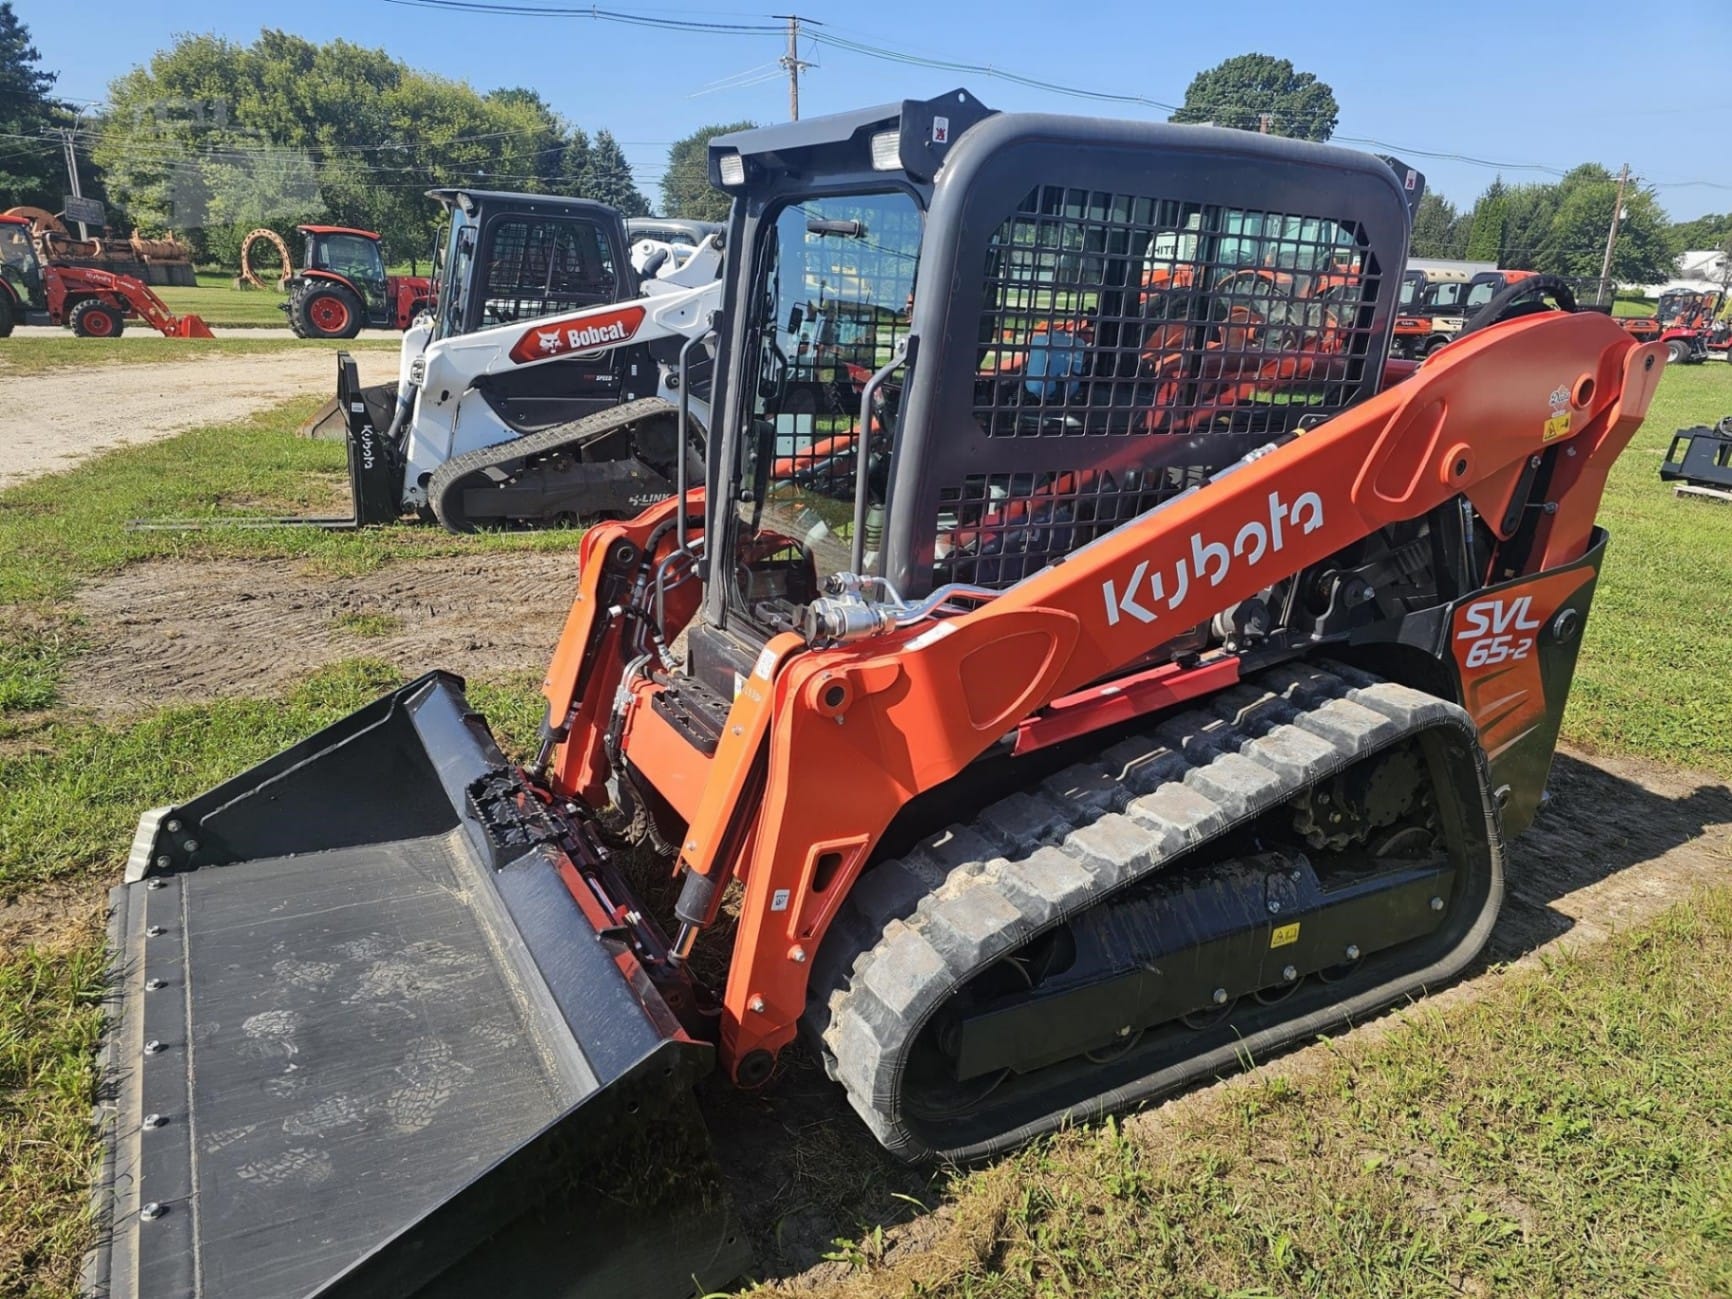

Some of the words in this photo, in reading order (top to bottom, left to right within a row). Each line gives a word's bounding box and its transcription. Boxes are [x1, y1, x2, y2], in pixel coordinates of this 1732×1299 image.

[567, 320, 626, 349] Bobcat
[360, 424, 376, 469] Kubota
[1102, 490, 1324, 627] Kubota
[1457, 596, 1540, 640] SVL
[1465, 634, 1533, 668] 65-2
